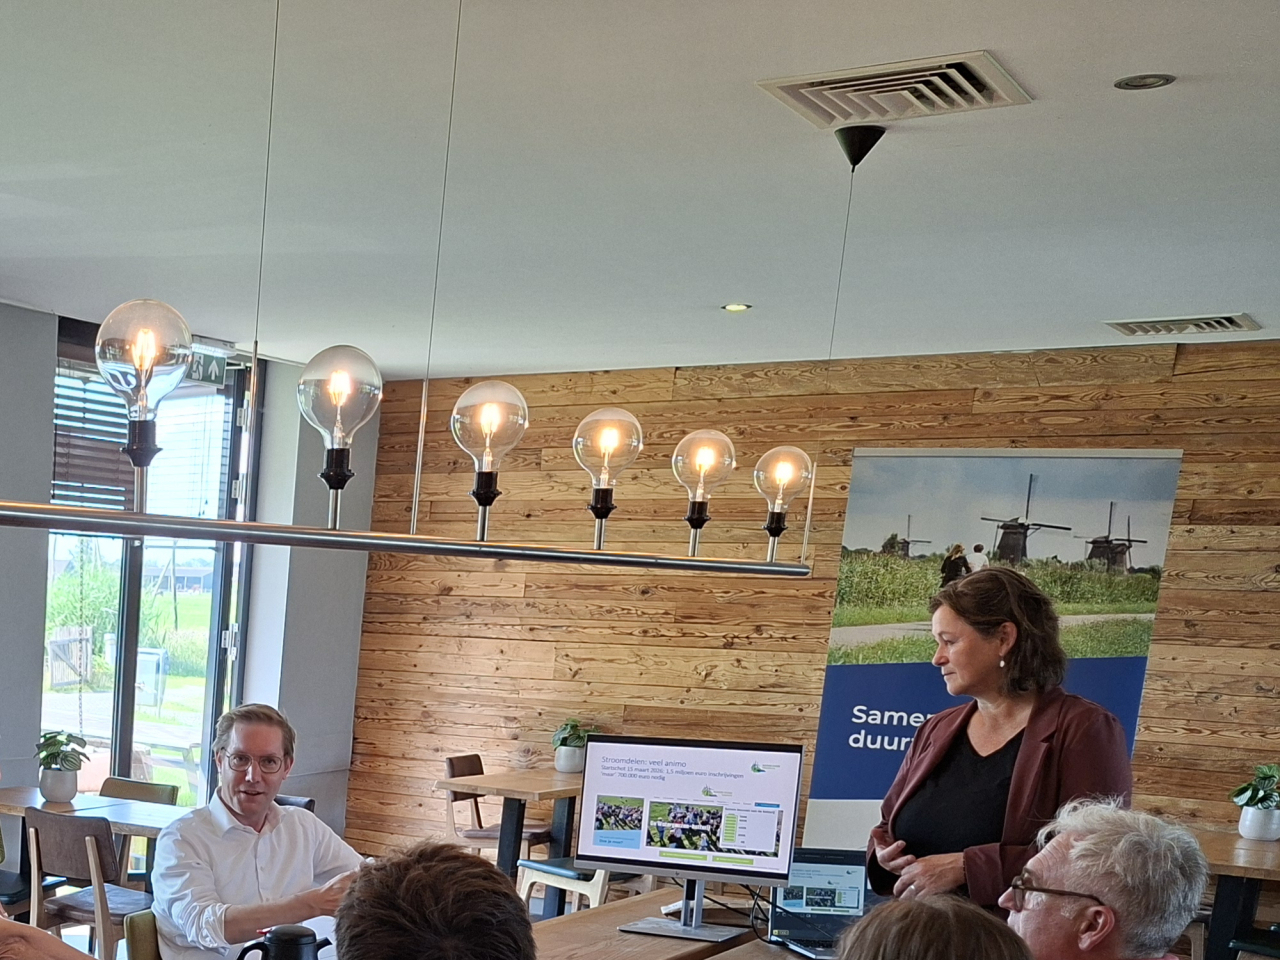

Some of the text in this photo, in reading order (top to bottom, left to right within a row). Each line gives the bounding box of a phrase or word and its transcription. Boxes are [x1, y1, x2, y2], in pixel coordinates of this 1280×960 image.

[848, 729, 915, 751] duur
[601, 756, 647, 765] Stroomdelen:
[664, 760, 687, 768] animo
[674, 768, 694, 776] miljoen
[708, 770, 744, 779] inschrijvingen
